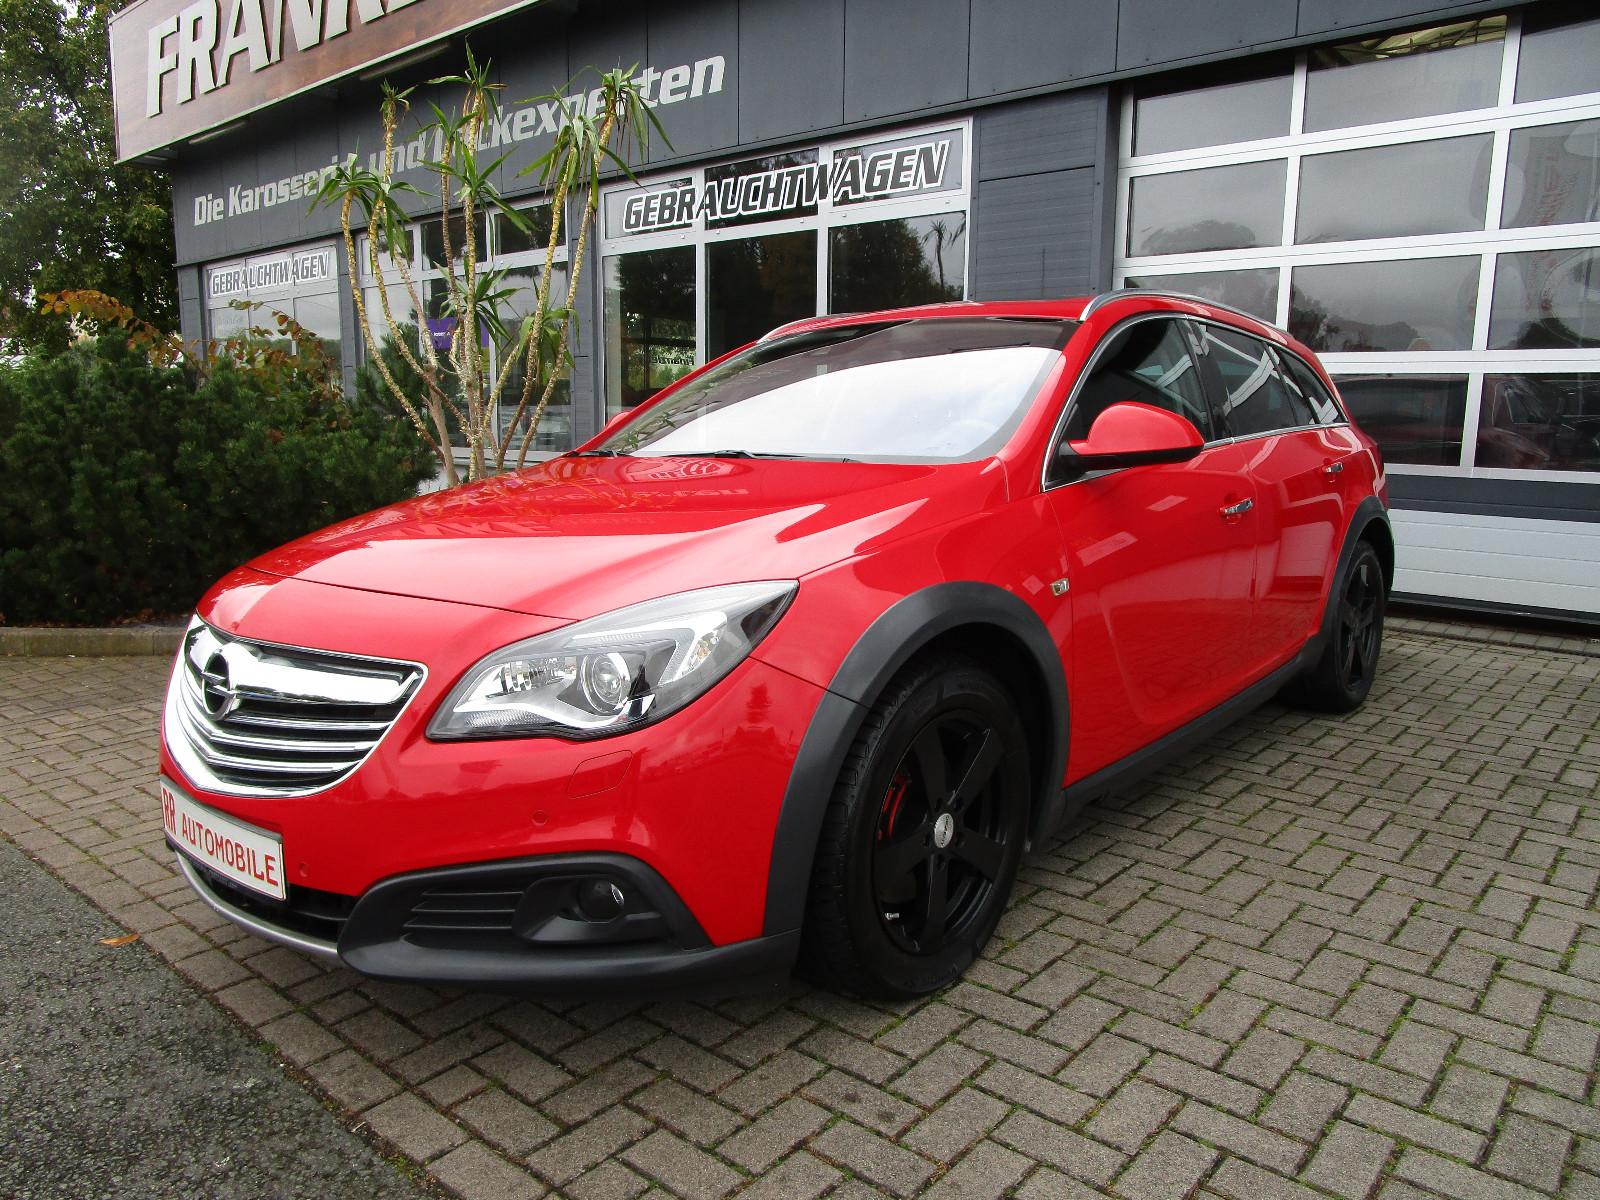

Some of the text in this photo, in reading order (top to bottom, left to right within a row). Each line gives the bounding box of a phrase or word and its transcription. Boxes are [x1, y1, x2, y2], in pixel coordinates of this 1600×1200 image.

[194, 193, 224, 226] Die
[622, 140, 951, 233] GEBRAUCHTWAGEN
[211, 252, 329, 296] GEBRAUCHTWAGEN
[162, 787, 279, 887] RR AUTOMOBILE
